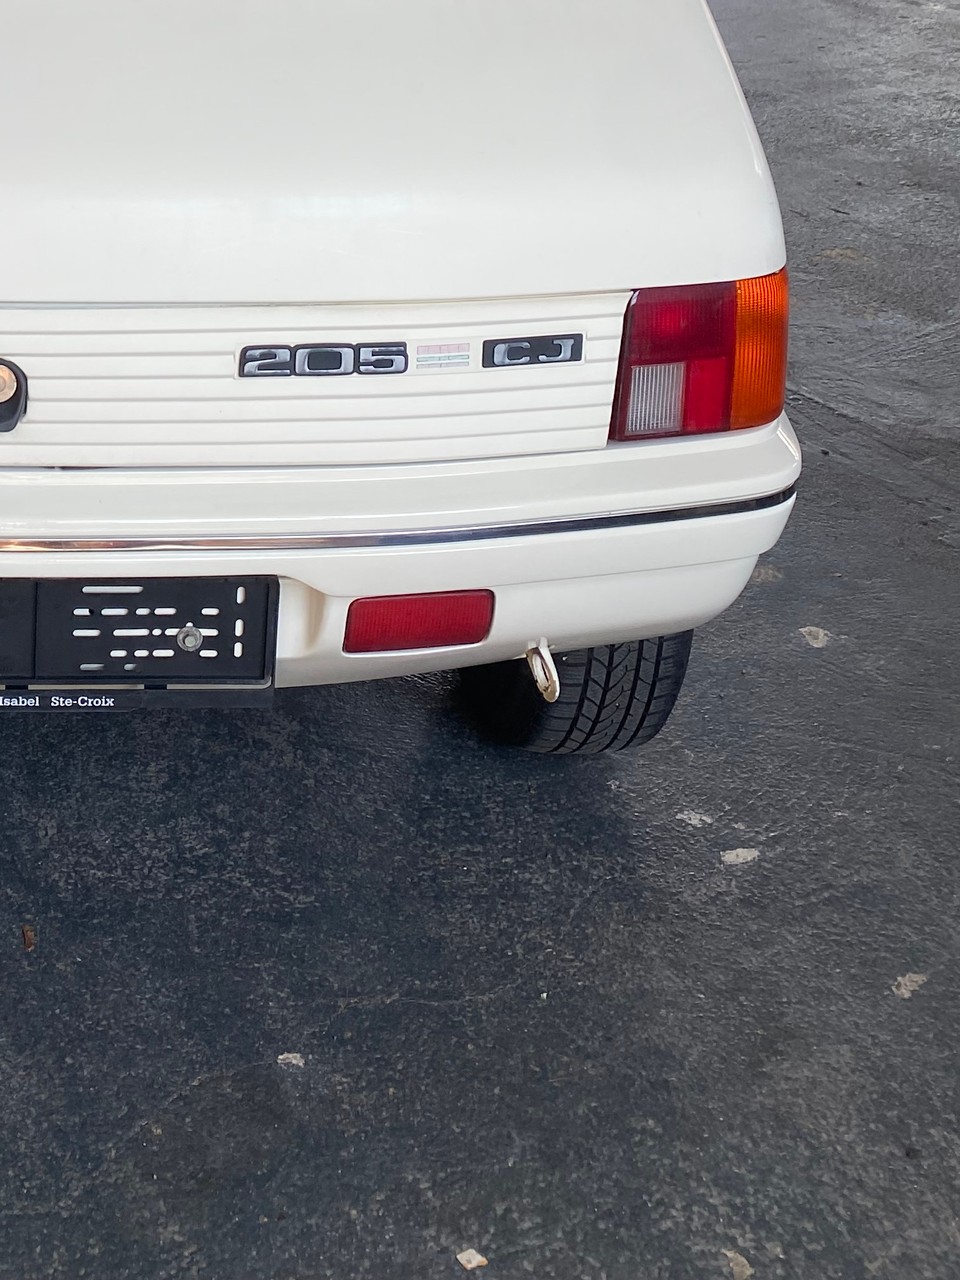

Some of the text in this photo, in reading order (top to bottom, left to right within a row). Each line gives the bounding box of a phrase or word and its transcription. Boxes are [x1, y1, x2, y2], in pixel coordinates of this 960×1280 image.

[242, 338, 576, 376] 205 CJ
[50, 695, 115, 707] Ste-Croix
